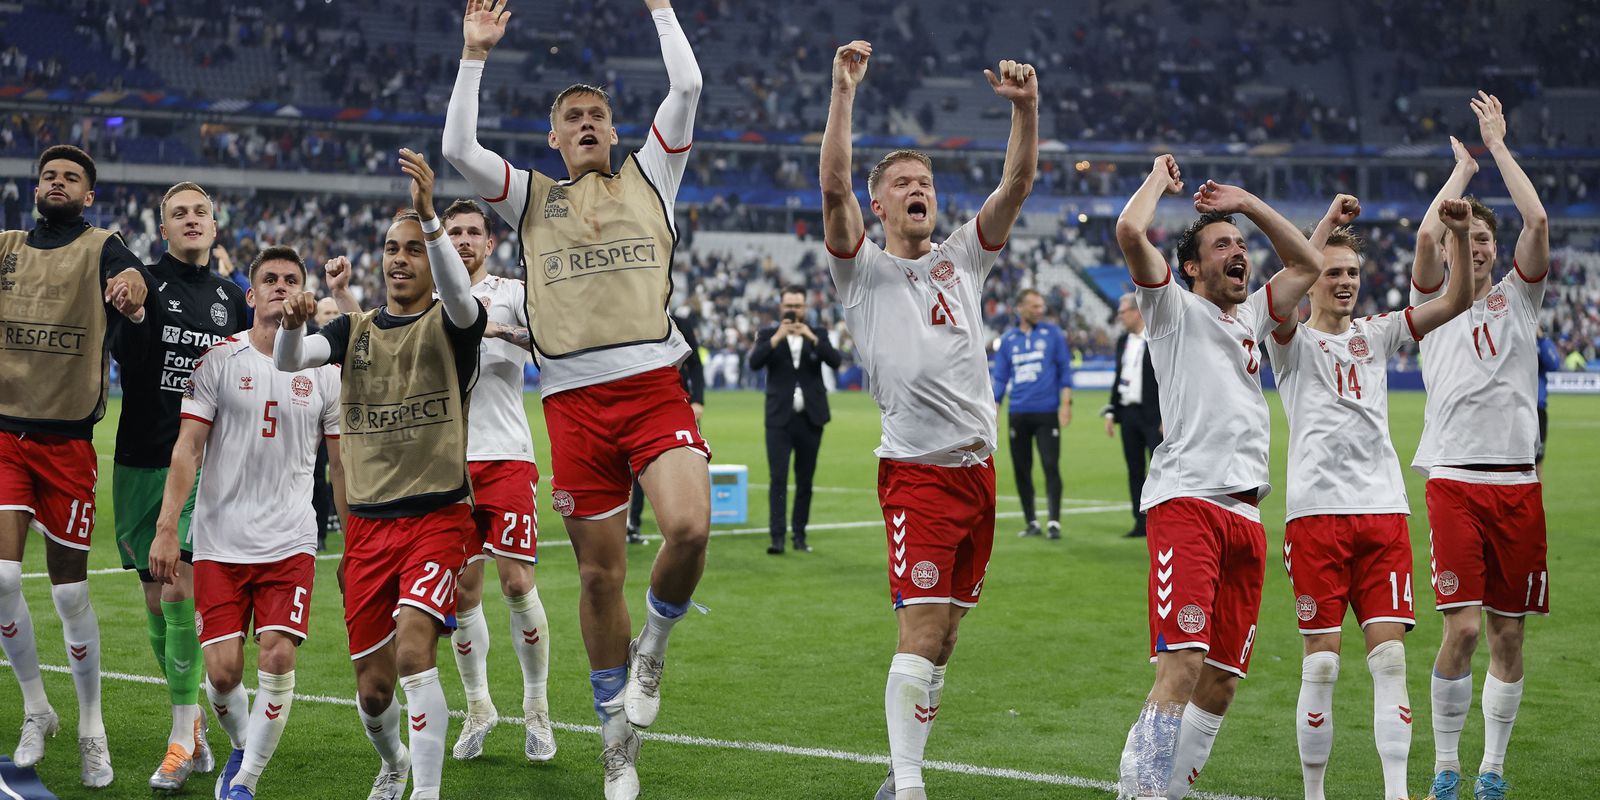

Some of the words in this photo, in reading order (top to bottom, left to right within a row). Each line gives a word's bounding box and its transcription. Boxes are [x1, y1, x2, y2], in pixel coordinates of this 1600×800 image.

[569, 244, 655, 271] RESPECT
[5, 327, 86, 349] RESPECT
[1473, 323, 1496, 360] 11
[1335, 362, 1361, 399] 14
[262, 400, 278, 438] 5
[66, 499, 92, 538] 15
[501, 512, 531, 549] 23
[410, 561, 453, 607] 20
[1389, 571, 1413, 611] 14
[1525, 571, 1546, 607] 11
[290, 586, 307, 624] 5
[1240, 624, 1256, 664] 8
